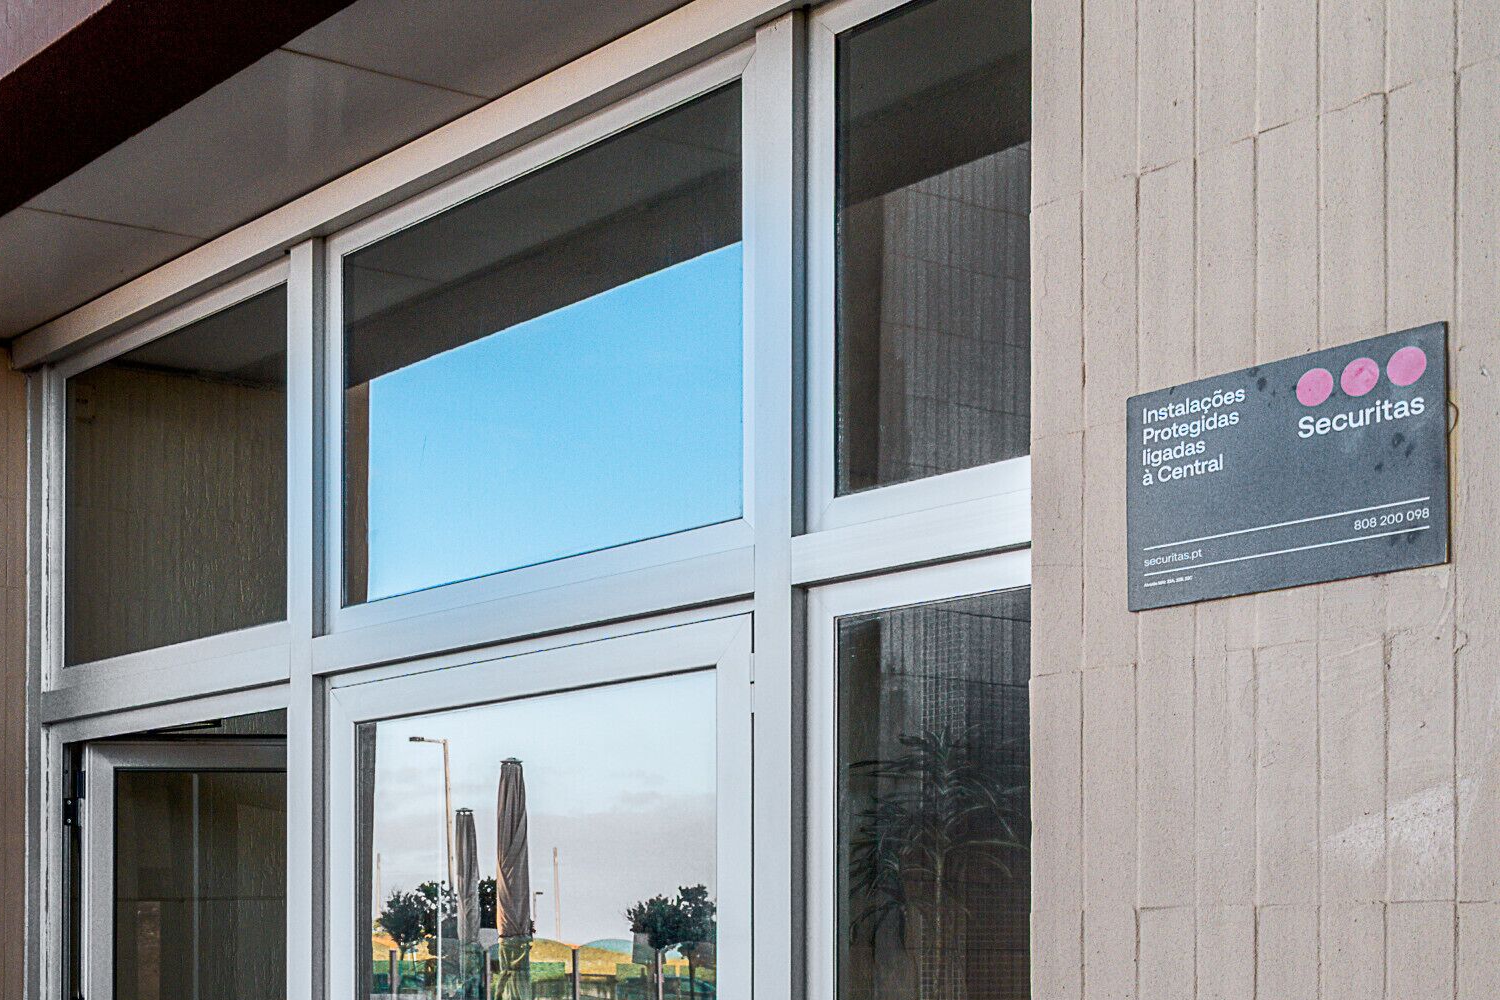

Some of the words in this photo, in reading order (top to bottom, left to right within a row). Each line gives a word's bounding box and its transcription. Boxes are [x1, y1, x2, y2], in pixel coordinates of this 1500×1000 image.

[1143, 388, 1246, 424] Instalações
[1297, 396, 1426, 438] Securitas
[1143, 411, 1240, 445] Protegidas
[1142, 440, 1206, 467] ligadas
[1142, 468, 1154, 486] à
[1157, 453, 1224, 482] Central
[1353, 517, 1377, 531] 808
[1379, 512, 1404, 527] 200
[1406, 507, 1430, 521] 098
[1143, 548, 1203, 567] securitas.pt
